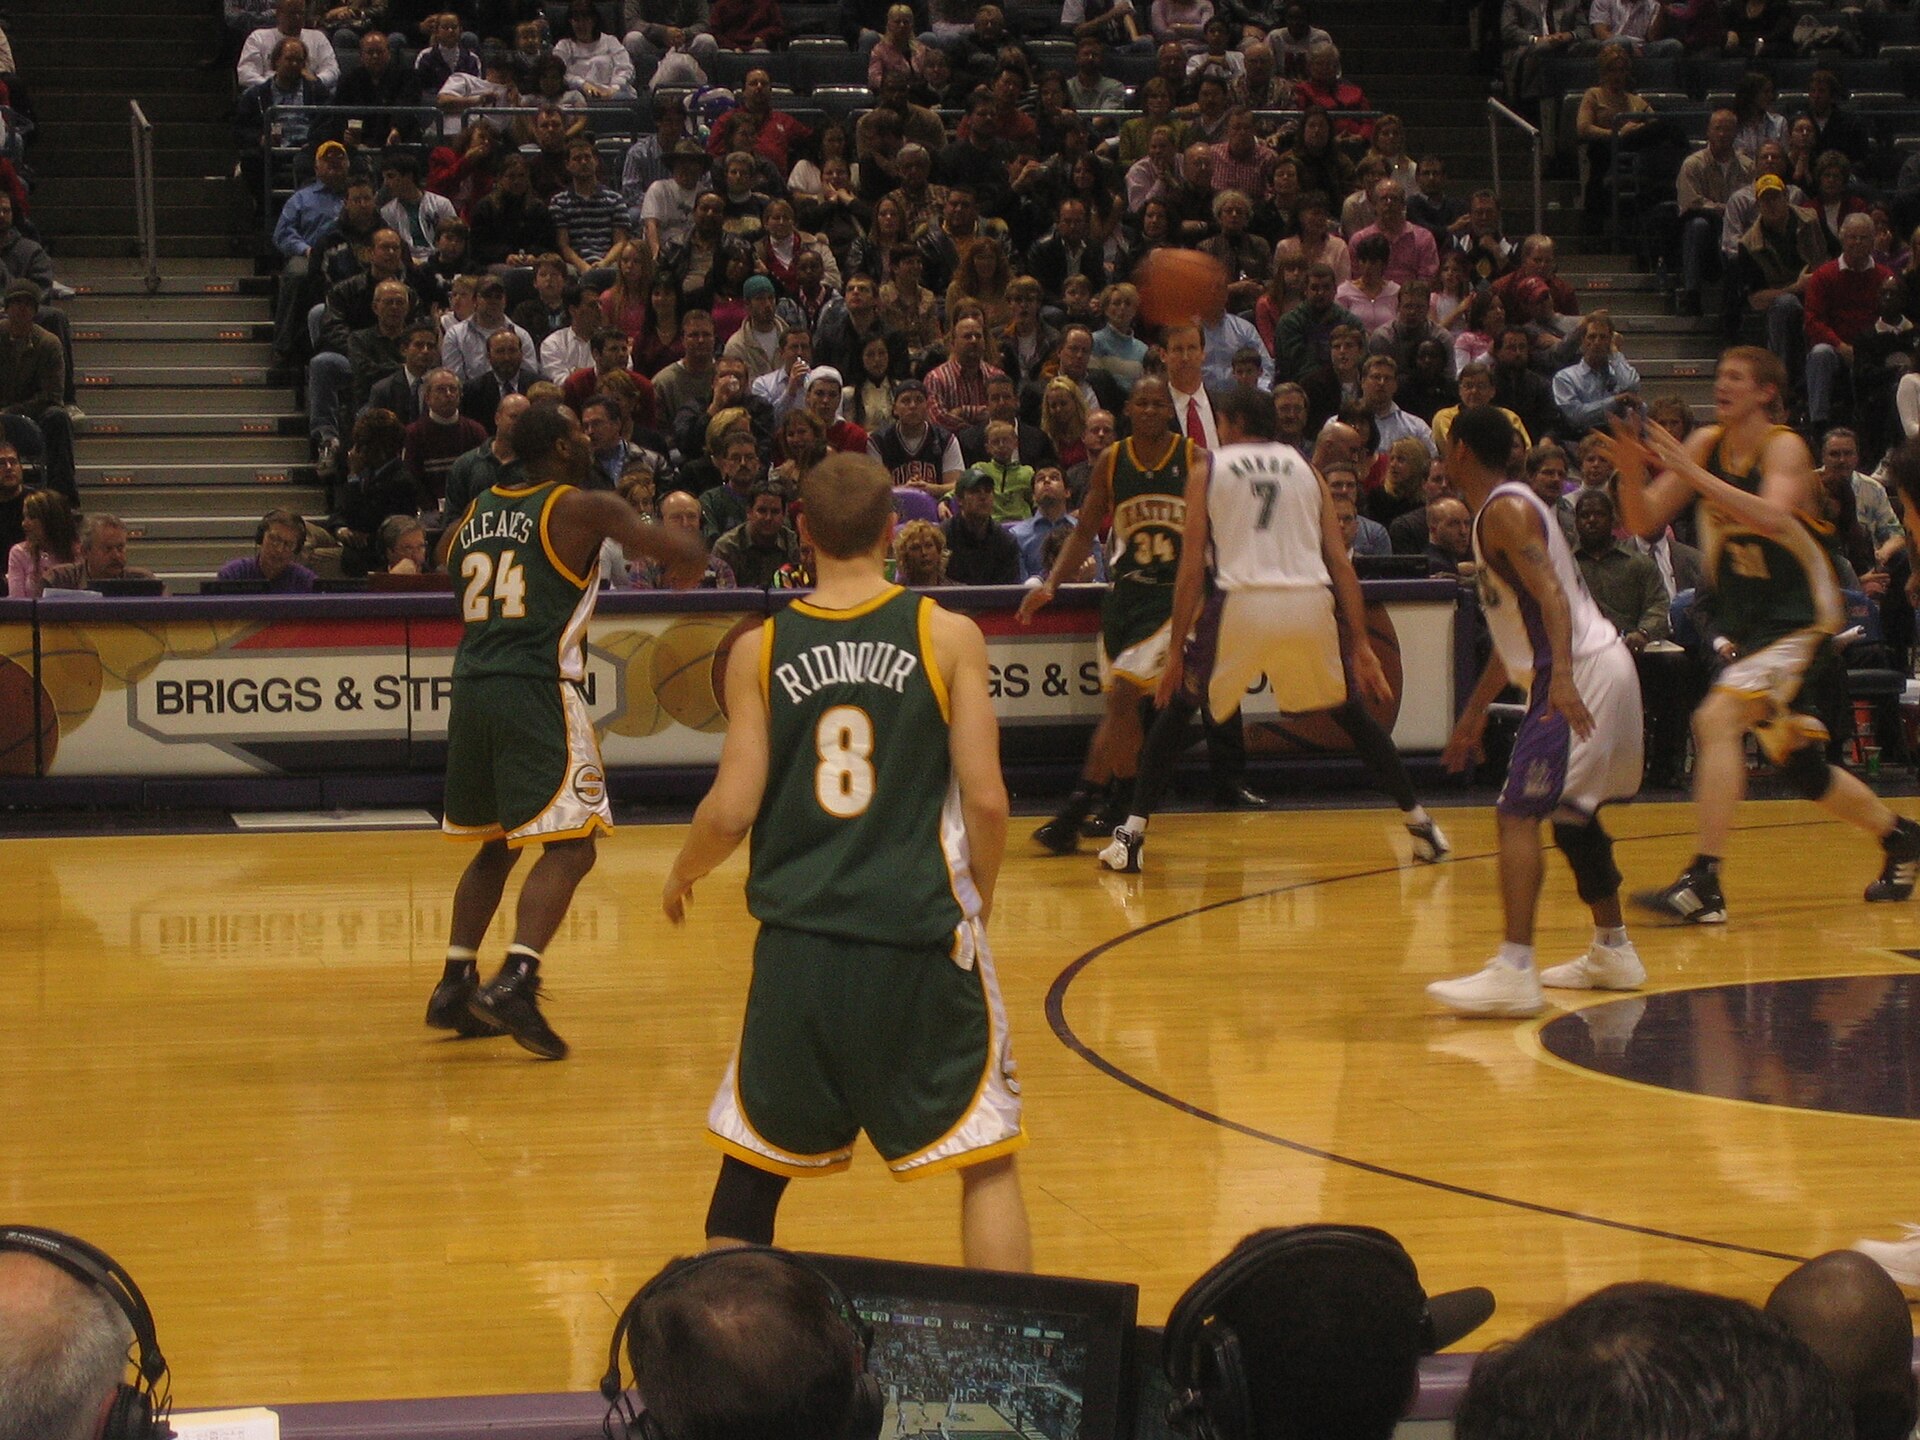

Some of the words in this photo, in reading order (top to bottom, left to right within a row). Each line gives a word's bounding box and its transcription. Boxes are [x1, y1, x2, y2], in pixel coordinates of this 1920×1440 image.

[1251, 480, 1281, 530] 7
[461, 550, 526, 622] 24
[156, 678, 322, 714] BRIGGS
[335, 676, 363, 711] &
[775, 641, 917, 704] RIDNOUR
[815, 704, 877, 819] 8
